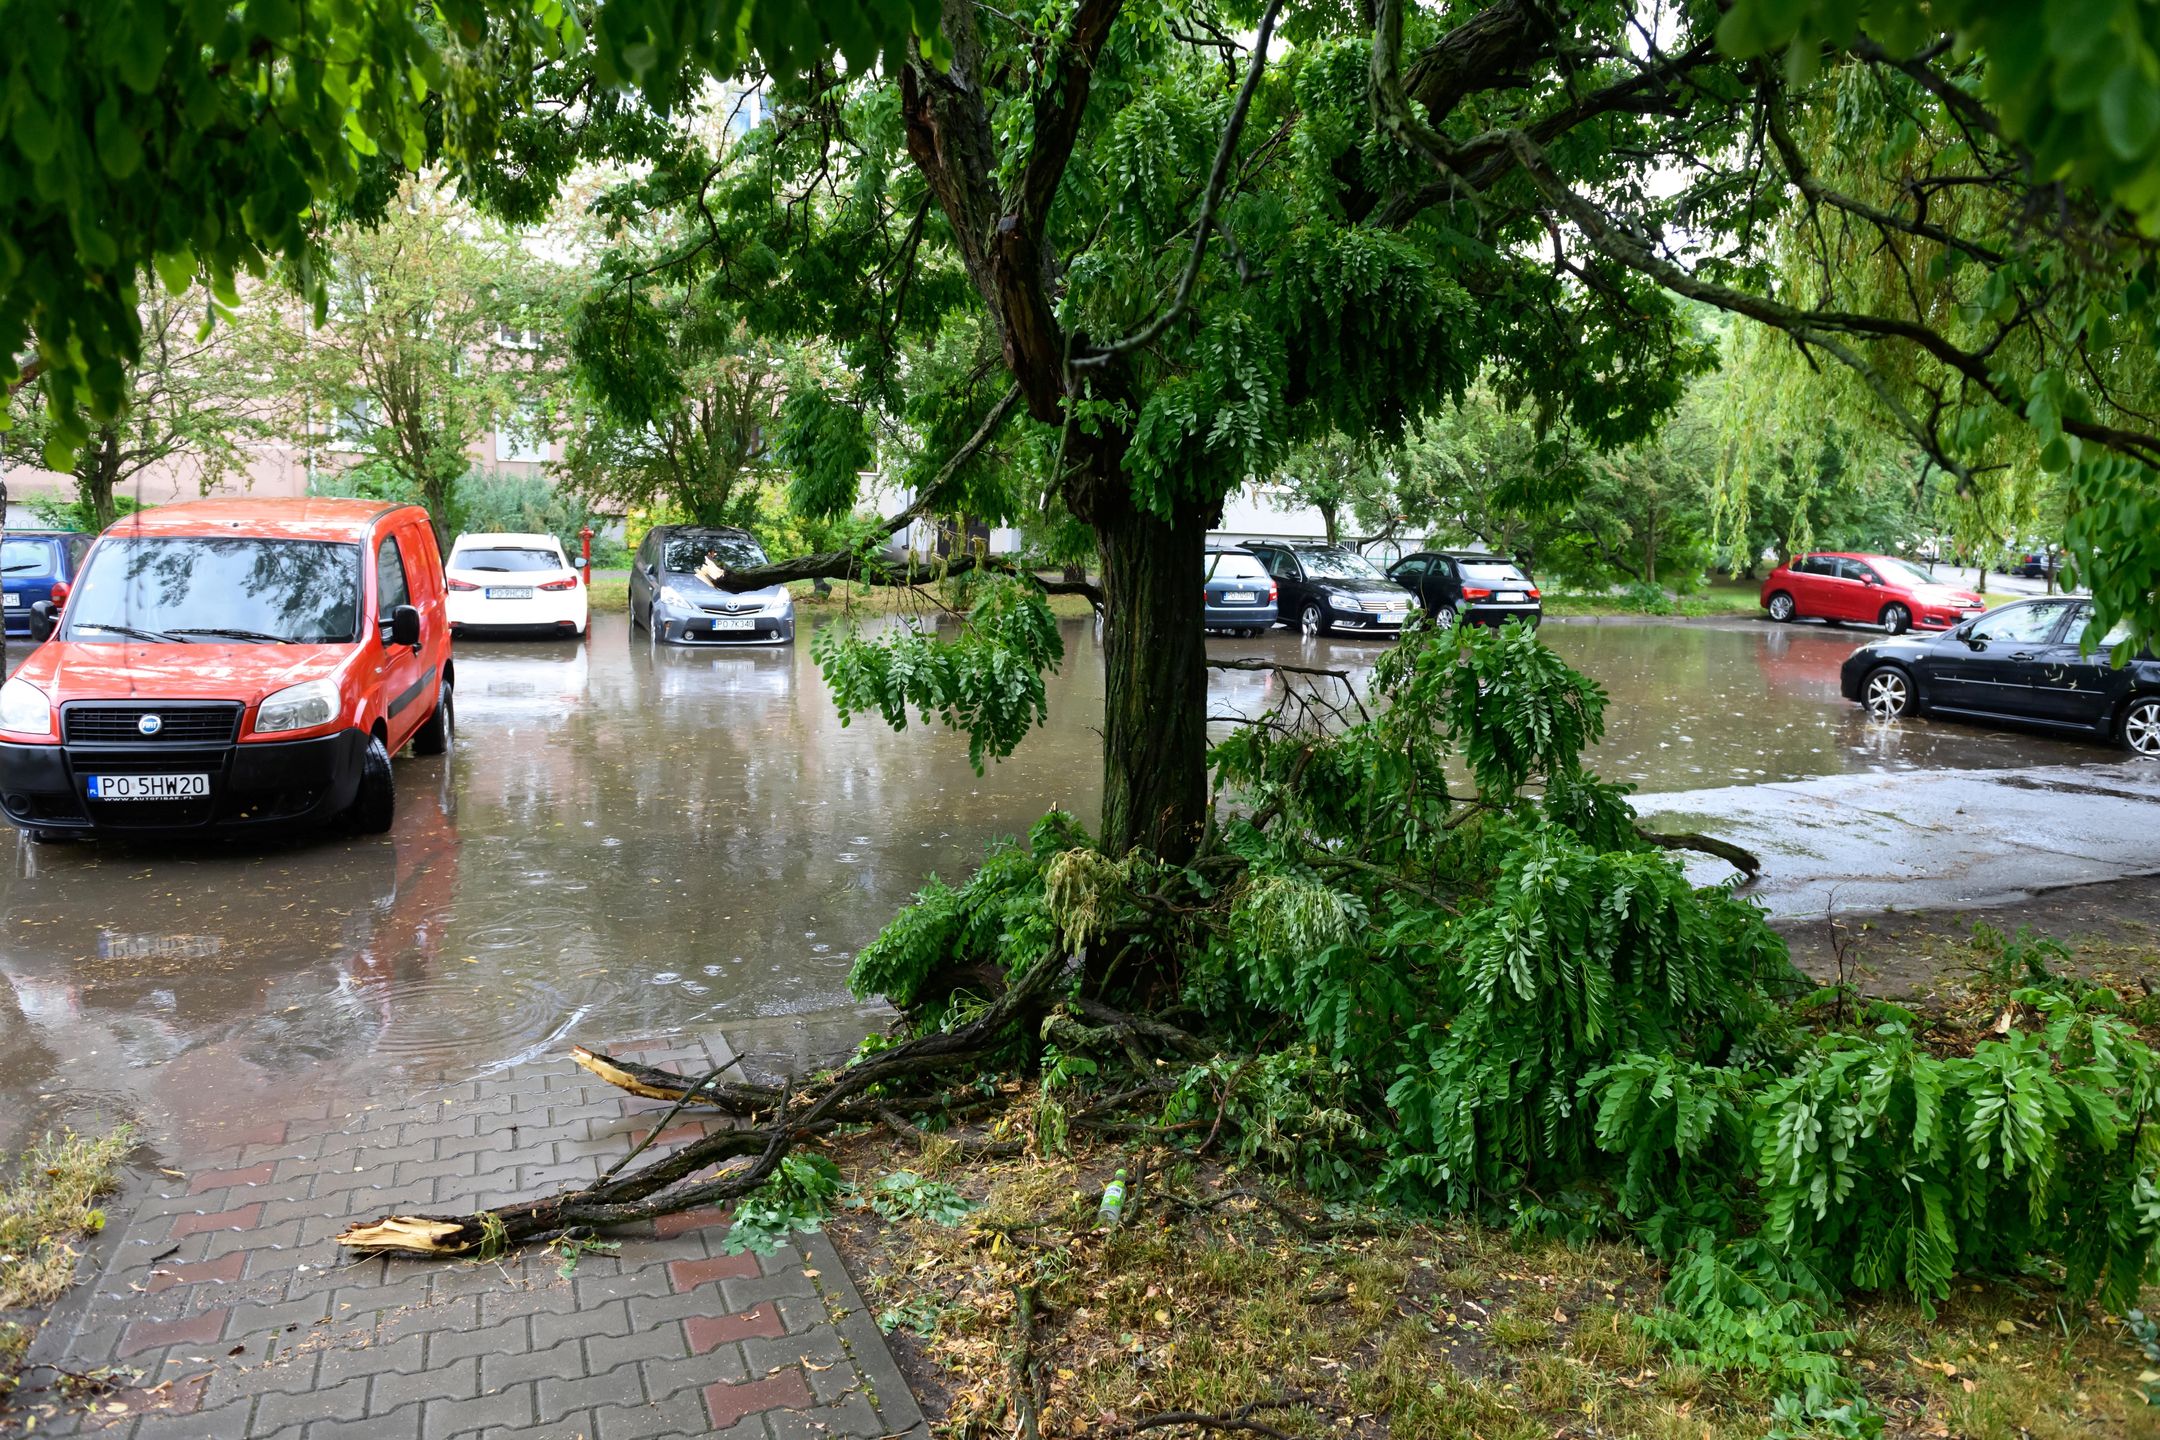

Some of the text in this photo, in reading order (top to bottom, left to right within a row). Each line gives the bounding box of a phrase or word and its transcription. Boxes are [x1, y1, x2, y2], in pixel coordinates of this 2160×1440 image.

[717, 620, 754, 628] PO 7K340
[102, 777, 204, 795] PO 5HW20
